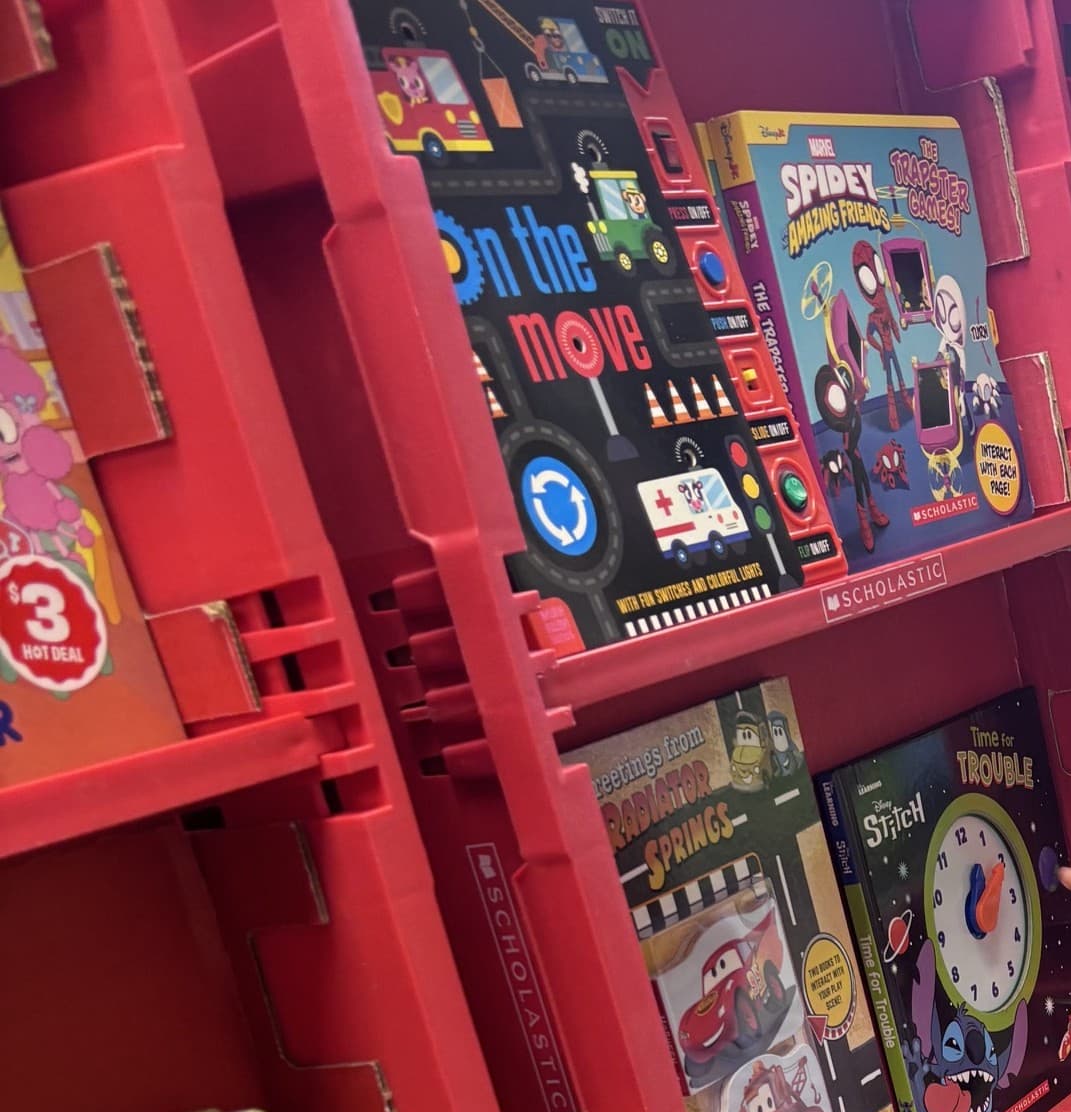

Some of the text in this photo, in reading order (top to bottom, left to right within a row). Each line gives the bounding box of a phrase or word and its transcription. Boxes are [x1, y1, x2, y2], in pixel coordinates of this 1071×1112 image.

[605, 28, 651, 61] ON
[808, 137, 836, 158] MARVEL
[920, 138, 938, 162] THE
[781, 164, 879, 216] SPIDEY
[890, 151, 970, 213] TRAPSTER
[908, 189, 961, 235] GAMES!
[739, 201, 759, 249] SPIDEY
[788, 201, 840, 257] AMAZING
[838, 199, 892, 234] FRIENDS
[505, 205, 597, 294] the
[752, 281, 771, 312] THE
[508, 305, 653, 382] move
[971, 325, 989, 341] TURN
[981, 444, 1012, 461] INTERACT
[980, 463, 1017, 480] WITH EACH
[990, 480, 1010, 497] PAGE!
[921, 496, 978, 520] SCHOLASTIC
[616, 562, 763, 615] WITH FUN SWITCHES AND COLORFUL LIGHTS
[841, 563, 942, 608] SCHOLASTIC
[21, 643, 84, 663] HOT DEAL
[970, 726, 1014, 747] Time for
[592, 725, 705, 799] reetings from
[956, 750, 1034, 789] TROUBLE
[600, 760, 714, 849] RADIATOR
[822, 781, 839, 827] LEARNING
[872, 800, 892, 813] Disney
[644, 801, 735, 891] SPRINGS
[955, 827, 968, 846] 12
[979, 830, 986, 846] 1
[937, 852, 948, 870] 11
[1009, 888, 1017, 904] 3
[937, 931, 946, 948] 9
[1014, 927, 1021, 942] 4
[951, 966, 960, 983] 8
[1007, 961, 1014, 976] 5
[487, 886, 568, 1109] SCHOLASTIC
[860, 933, 896, 1049] Time for Trouble
[971, 984, 978, 1001] 7
[992, 982, 999, 997] 6
